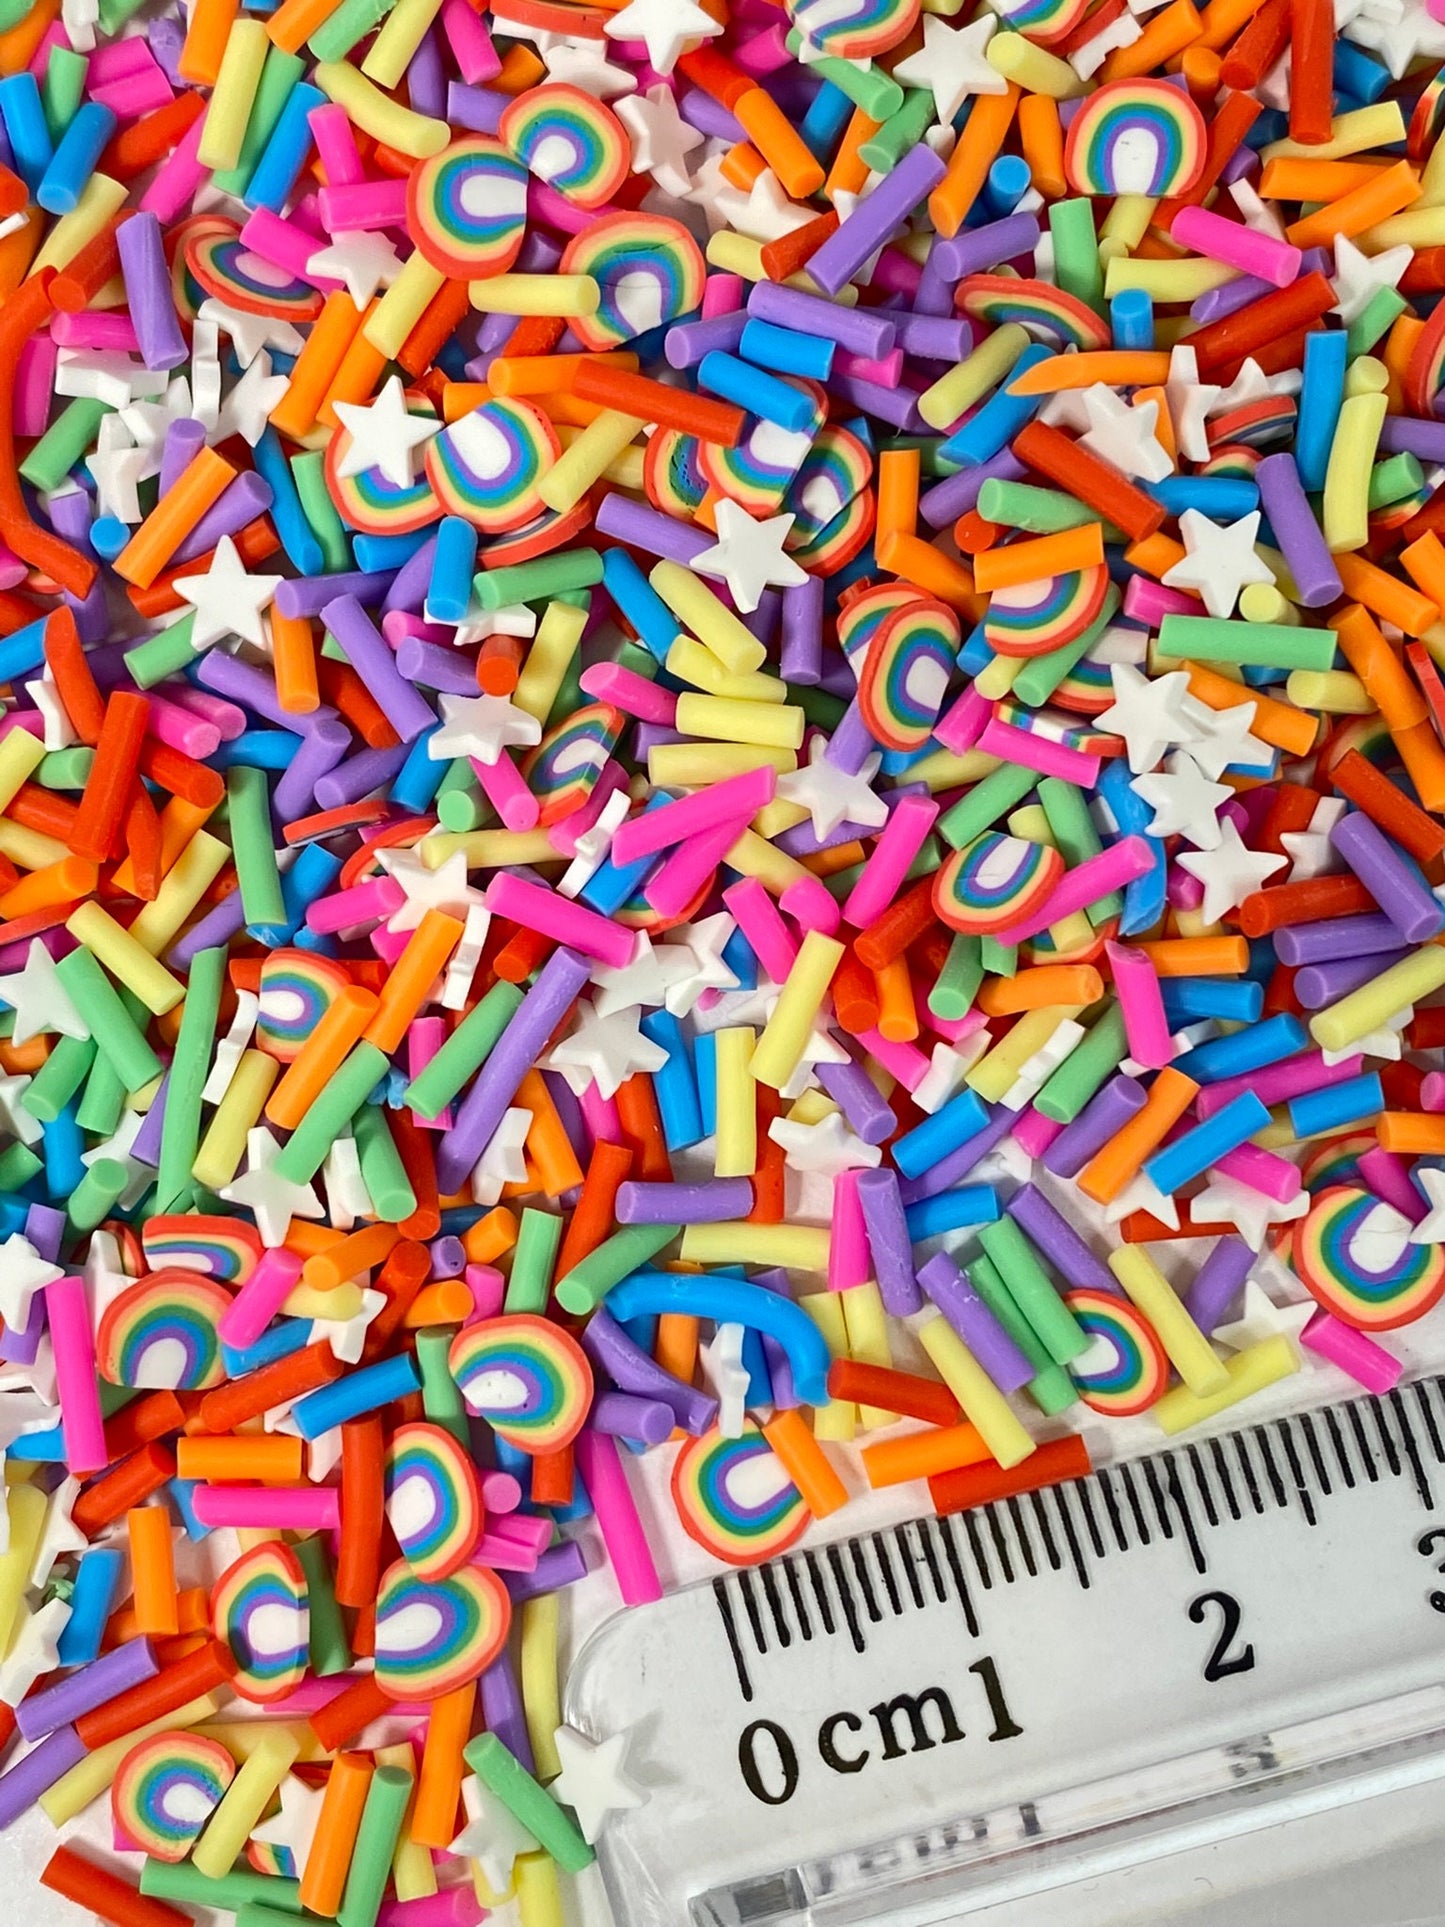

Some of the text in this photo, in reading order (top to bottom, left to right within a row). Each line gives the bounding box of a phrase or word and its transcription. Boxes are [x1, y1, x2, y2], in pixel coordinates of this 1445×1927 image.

[738, 1590, 1255, 1806] 0 cm 1 2
